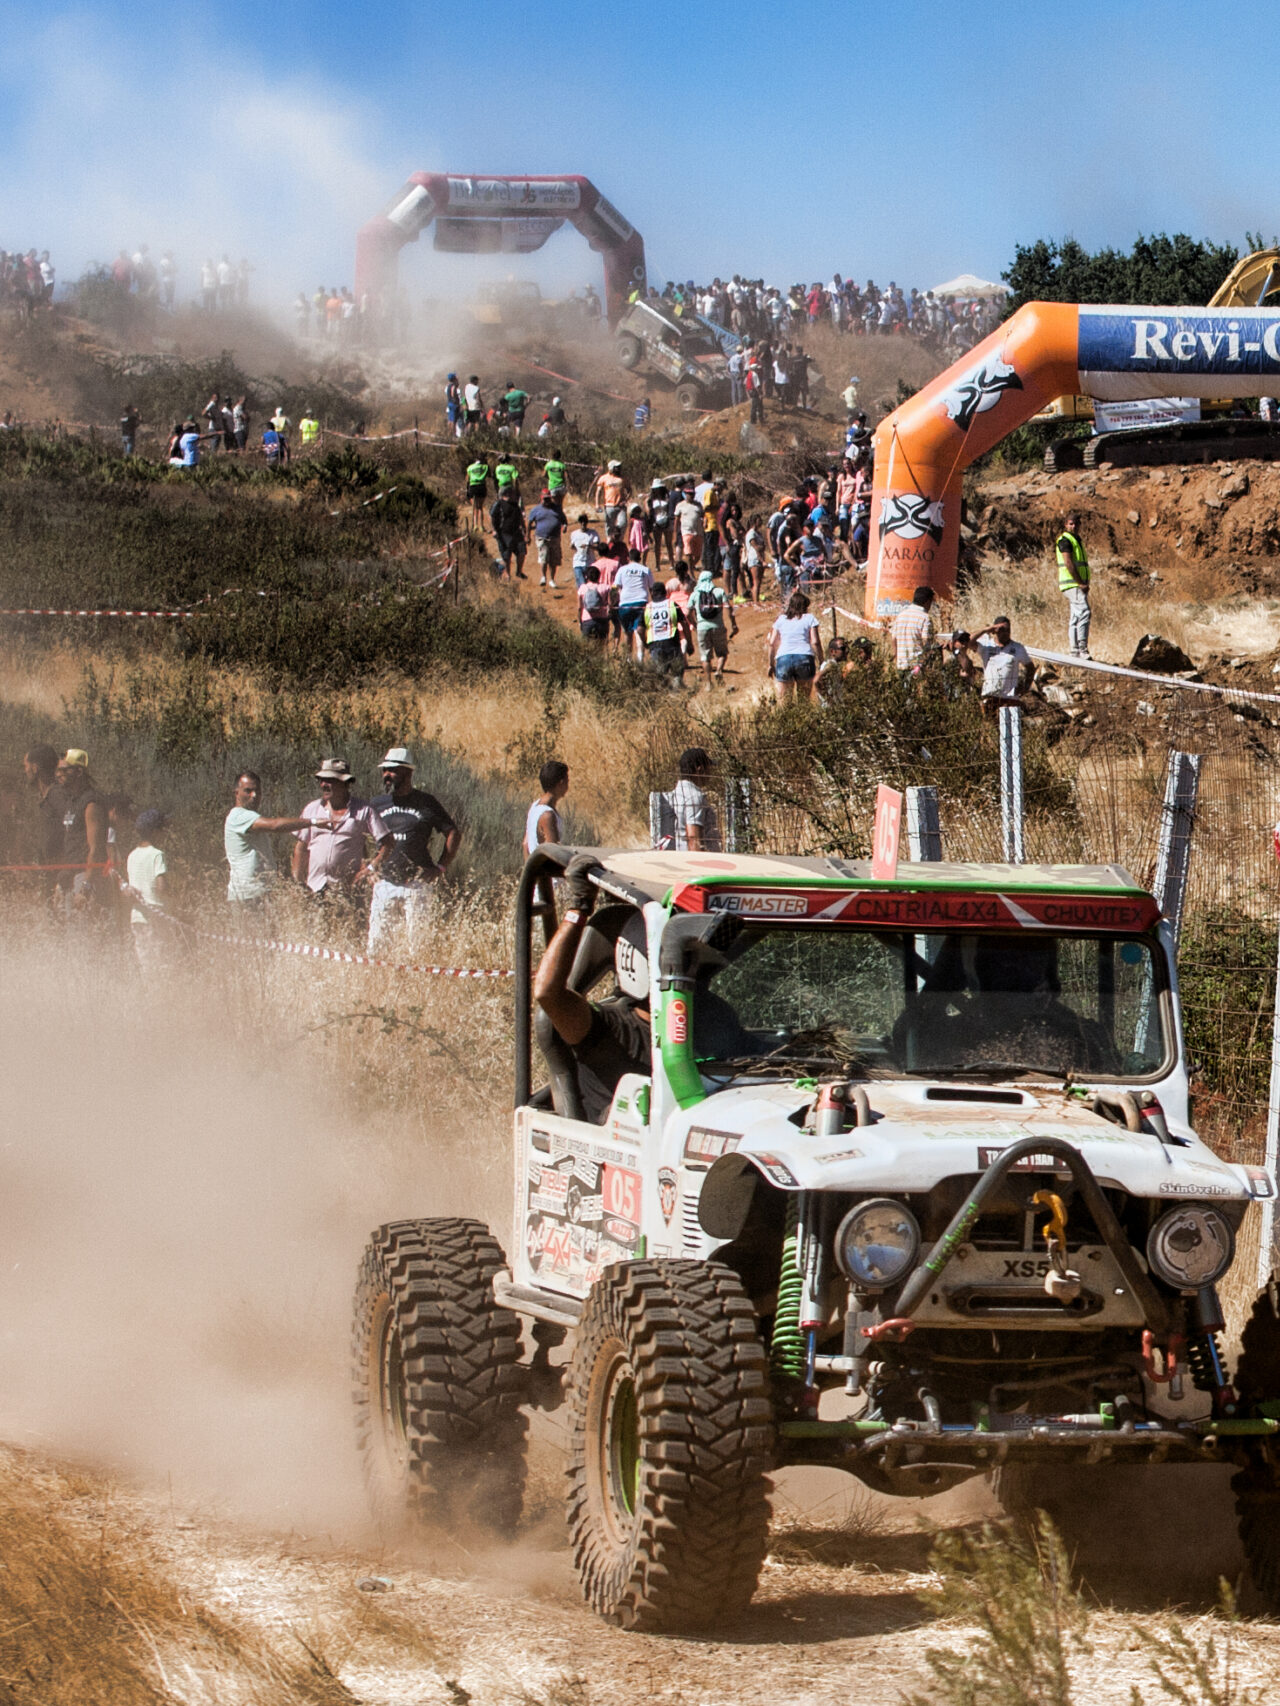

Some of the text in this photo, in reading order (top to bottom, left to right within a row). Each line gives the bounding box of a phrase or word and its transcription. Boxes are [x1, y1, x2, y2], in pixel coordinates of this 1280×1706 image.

[879, 800, 897, 867] 05
[1043, 903, 1144, 922] CHUVITEX
[610, 1169, 636, 1218] 05
[1159, 1182, 1232, 1196] SkinOvelha
